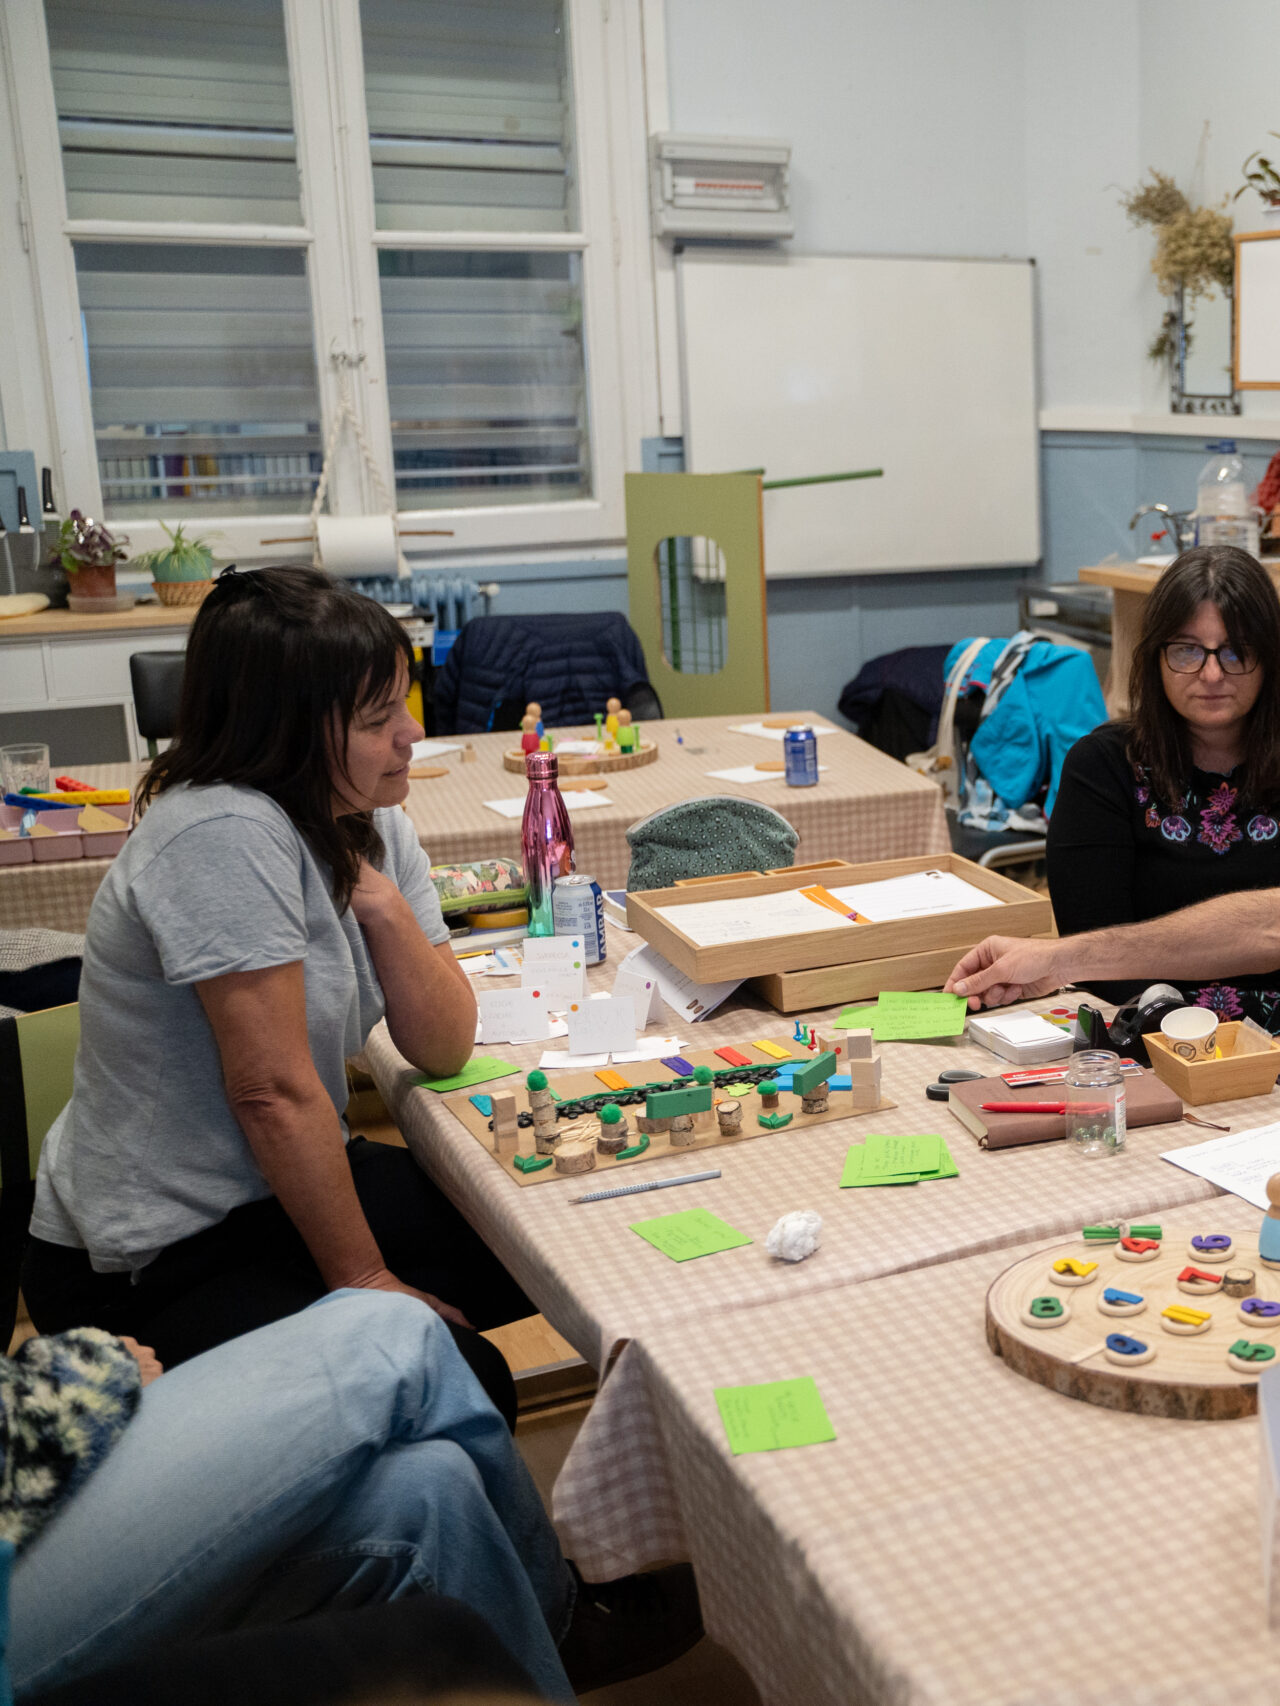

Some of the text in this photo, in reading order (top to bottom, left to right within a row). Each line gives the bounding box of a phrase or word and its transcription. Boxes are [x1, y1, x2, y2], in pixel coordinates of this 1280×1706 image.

[597, 895, 607, 955] AMBAR
[1121, 1237, 1160, 1254] 4
[1191, 1234, 1232, 1251] 6
[1053, 1258, 1099, 1277] 2
[1177, 1266, 1222, 1283] 7
[1103, 1288, 1144, 1305] 1
[1030, 1296, 1064, 1318] 8
[1105, 1333, 1148, 1356] 9
[1228, 1339, 1276, 1362] 5
